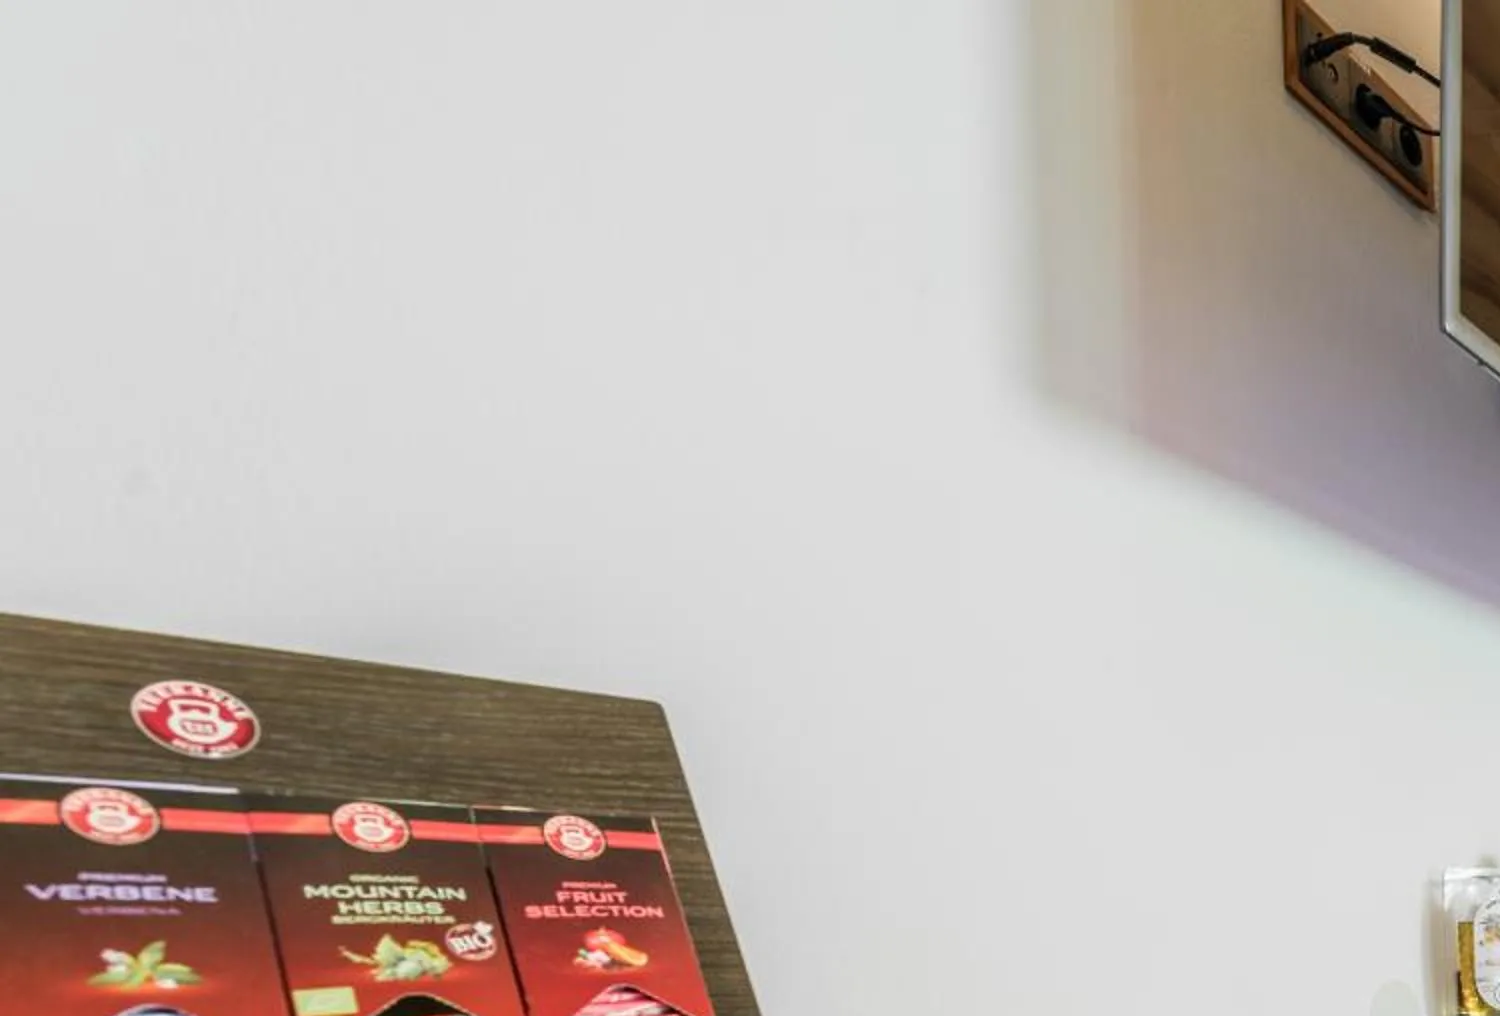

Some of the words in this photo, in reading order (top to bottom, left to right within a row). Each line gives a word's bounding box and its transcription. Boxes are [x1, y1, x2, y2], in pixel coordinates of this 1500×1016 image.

[23, 883, 220, 903] VERBENE
[303, 883, 468, 901] MOUNTAIN
[556, 890, 629, 904] FRUIT
[337, 901, 446, 916] HERBS
[524, 904, 665, 919] SELECTION
